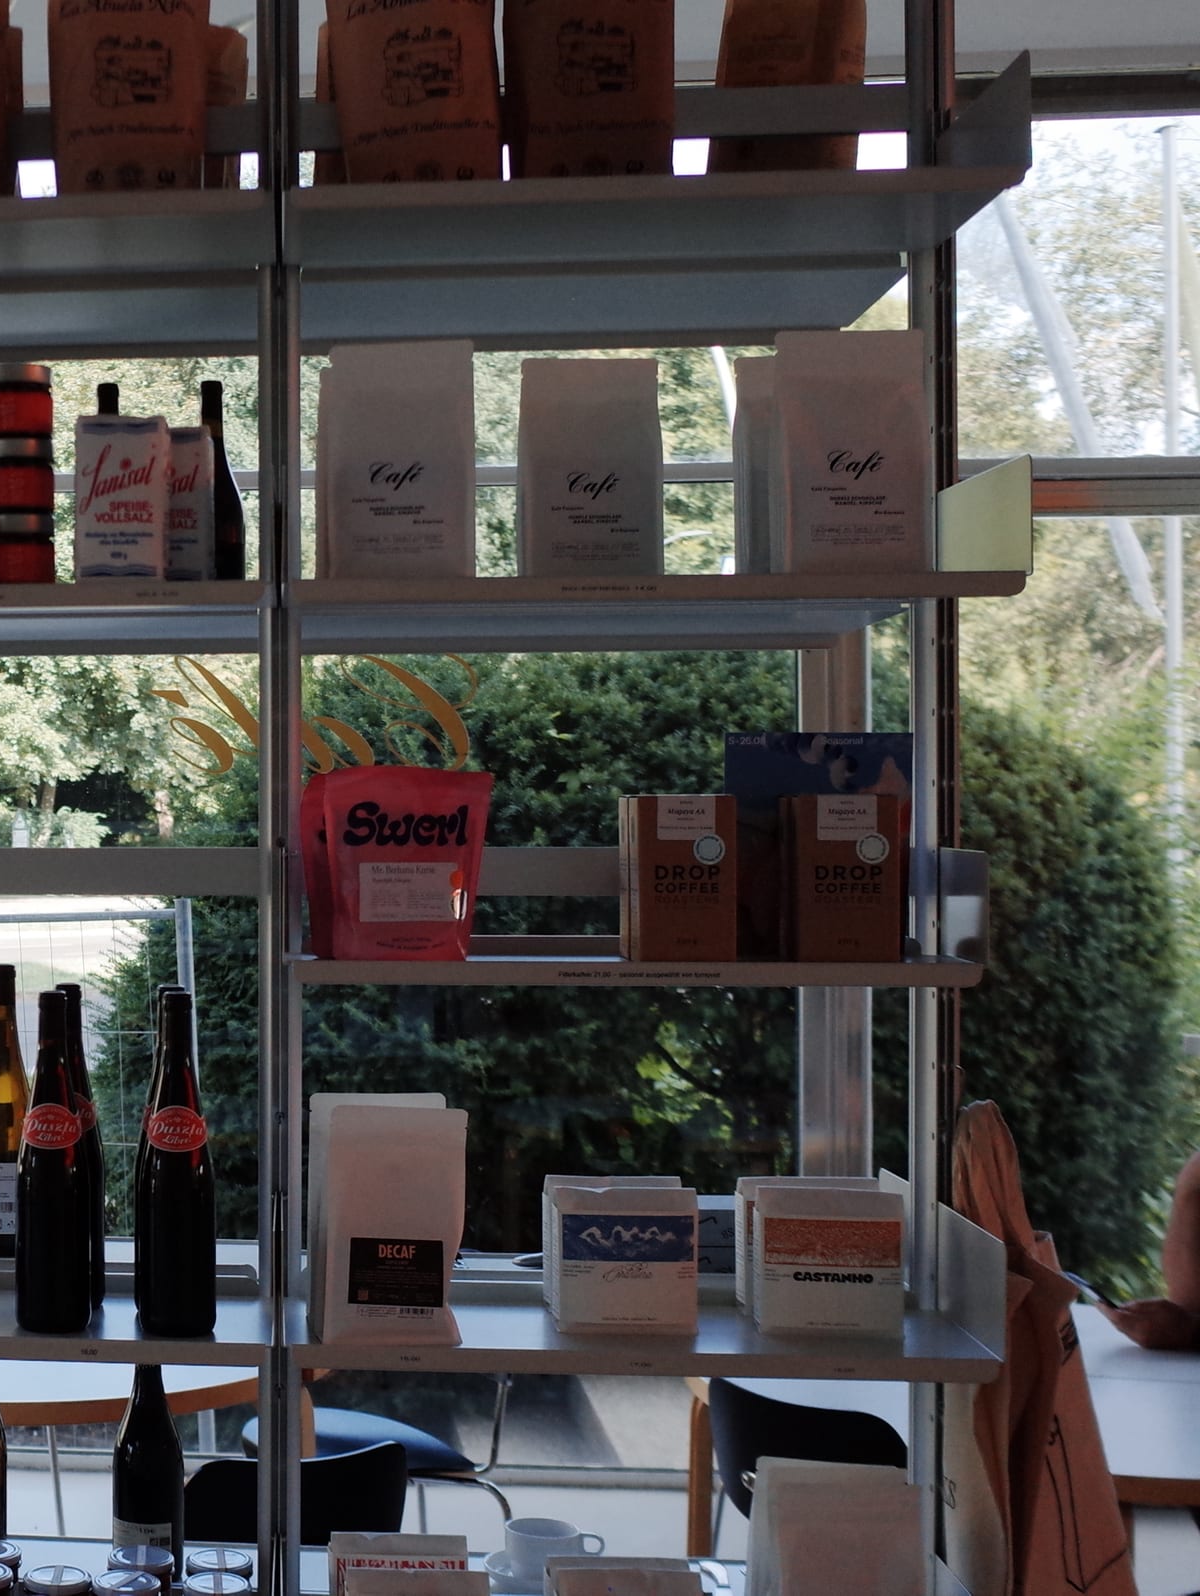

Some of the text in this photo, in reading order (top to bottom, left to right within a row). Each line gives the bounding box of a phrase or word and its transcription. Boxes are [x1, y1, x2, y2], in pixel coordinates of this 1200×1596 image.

[826, 448, 885, 481] Café
[369, 462, 424, 491] Café
[566, 471, 620, 500] Café
[109, 501, 153, 511] SPEISE-
[94, 512, 154, 523] VOLLSALZ
[343, 801, 469, 847] Swerl
[654, 865, 721, 881] DROP
[815, 865, 883, 881] DROP
[654, 882, 720, 894] COFFEE
[814, 882, 881, 894] COFFEE
[654, 895, 720, 904] ROASTERS
[814, 895, 881, 904] ROASTERS
[27, 1119, 77, 1134] Puszta
[152, 1121, 203, 1137] Puszta
[378, 1244, 416, 1259] DECAF
[793, 1271, 874, 1284] CASTANHO
